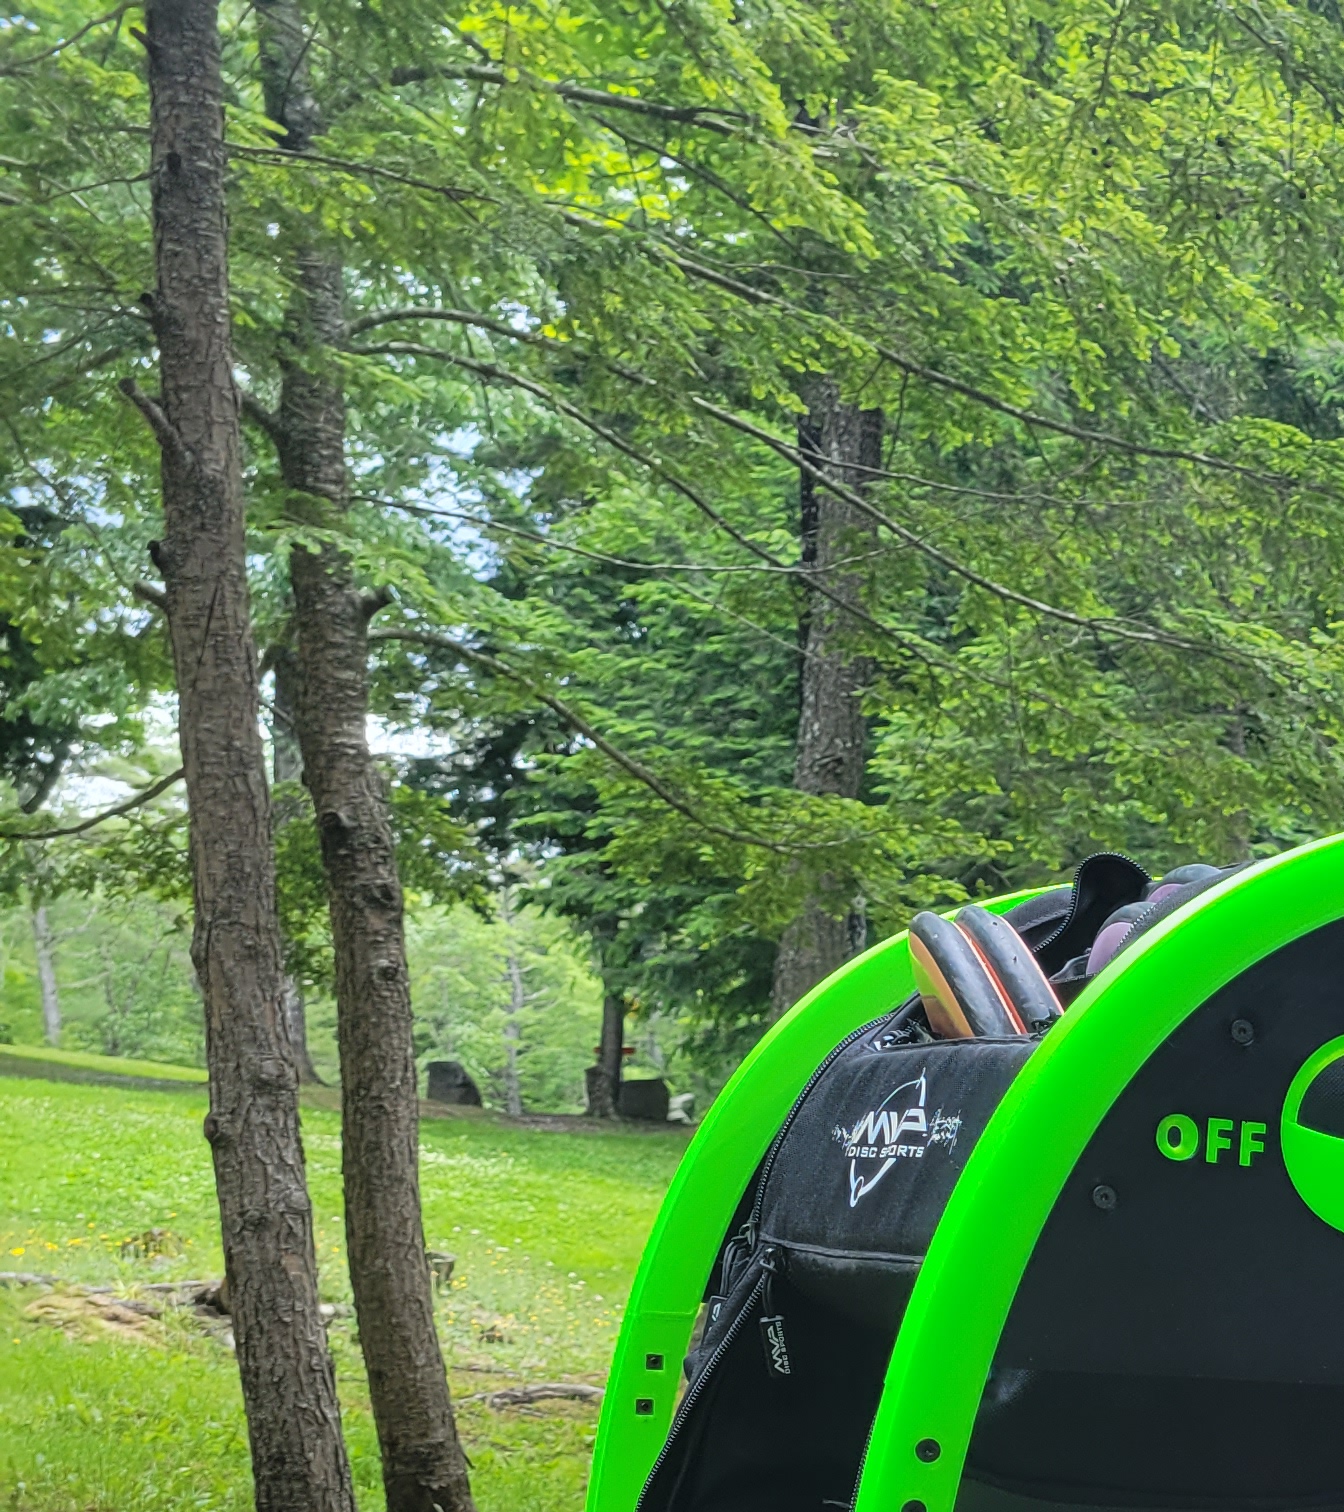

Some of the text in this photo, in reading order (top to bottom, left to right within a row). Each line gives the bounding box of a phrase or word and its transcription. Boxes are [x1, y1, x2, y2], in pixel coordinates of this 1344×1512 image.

[850, 1108, 927, 1144] MVP
[1156, 1113, 1267, 1167] OFF
[848, 1146, 878, 1158] DISC
[767, 1325, 785, 1373] MVP
